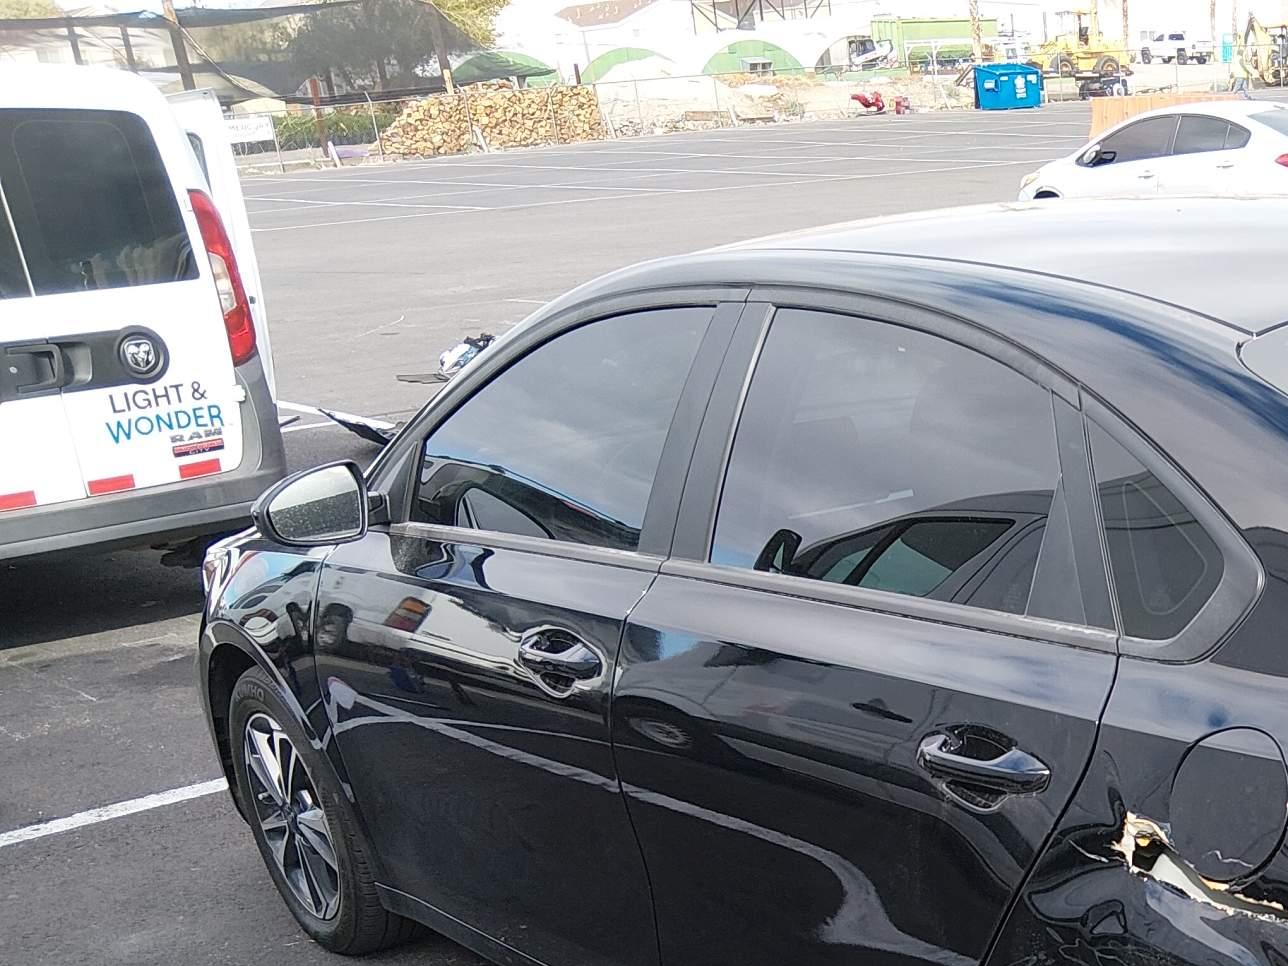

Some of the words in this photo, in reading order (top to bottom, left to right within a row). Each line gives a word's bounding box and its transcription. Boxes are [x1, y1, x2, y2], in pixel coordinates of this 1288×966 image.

[108, 383, 184, 414] LIGHT
[191, 380, 208, 400] &
[105, 404, 225, 444] WONDER
[169, 428, 223, 443] RAM
